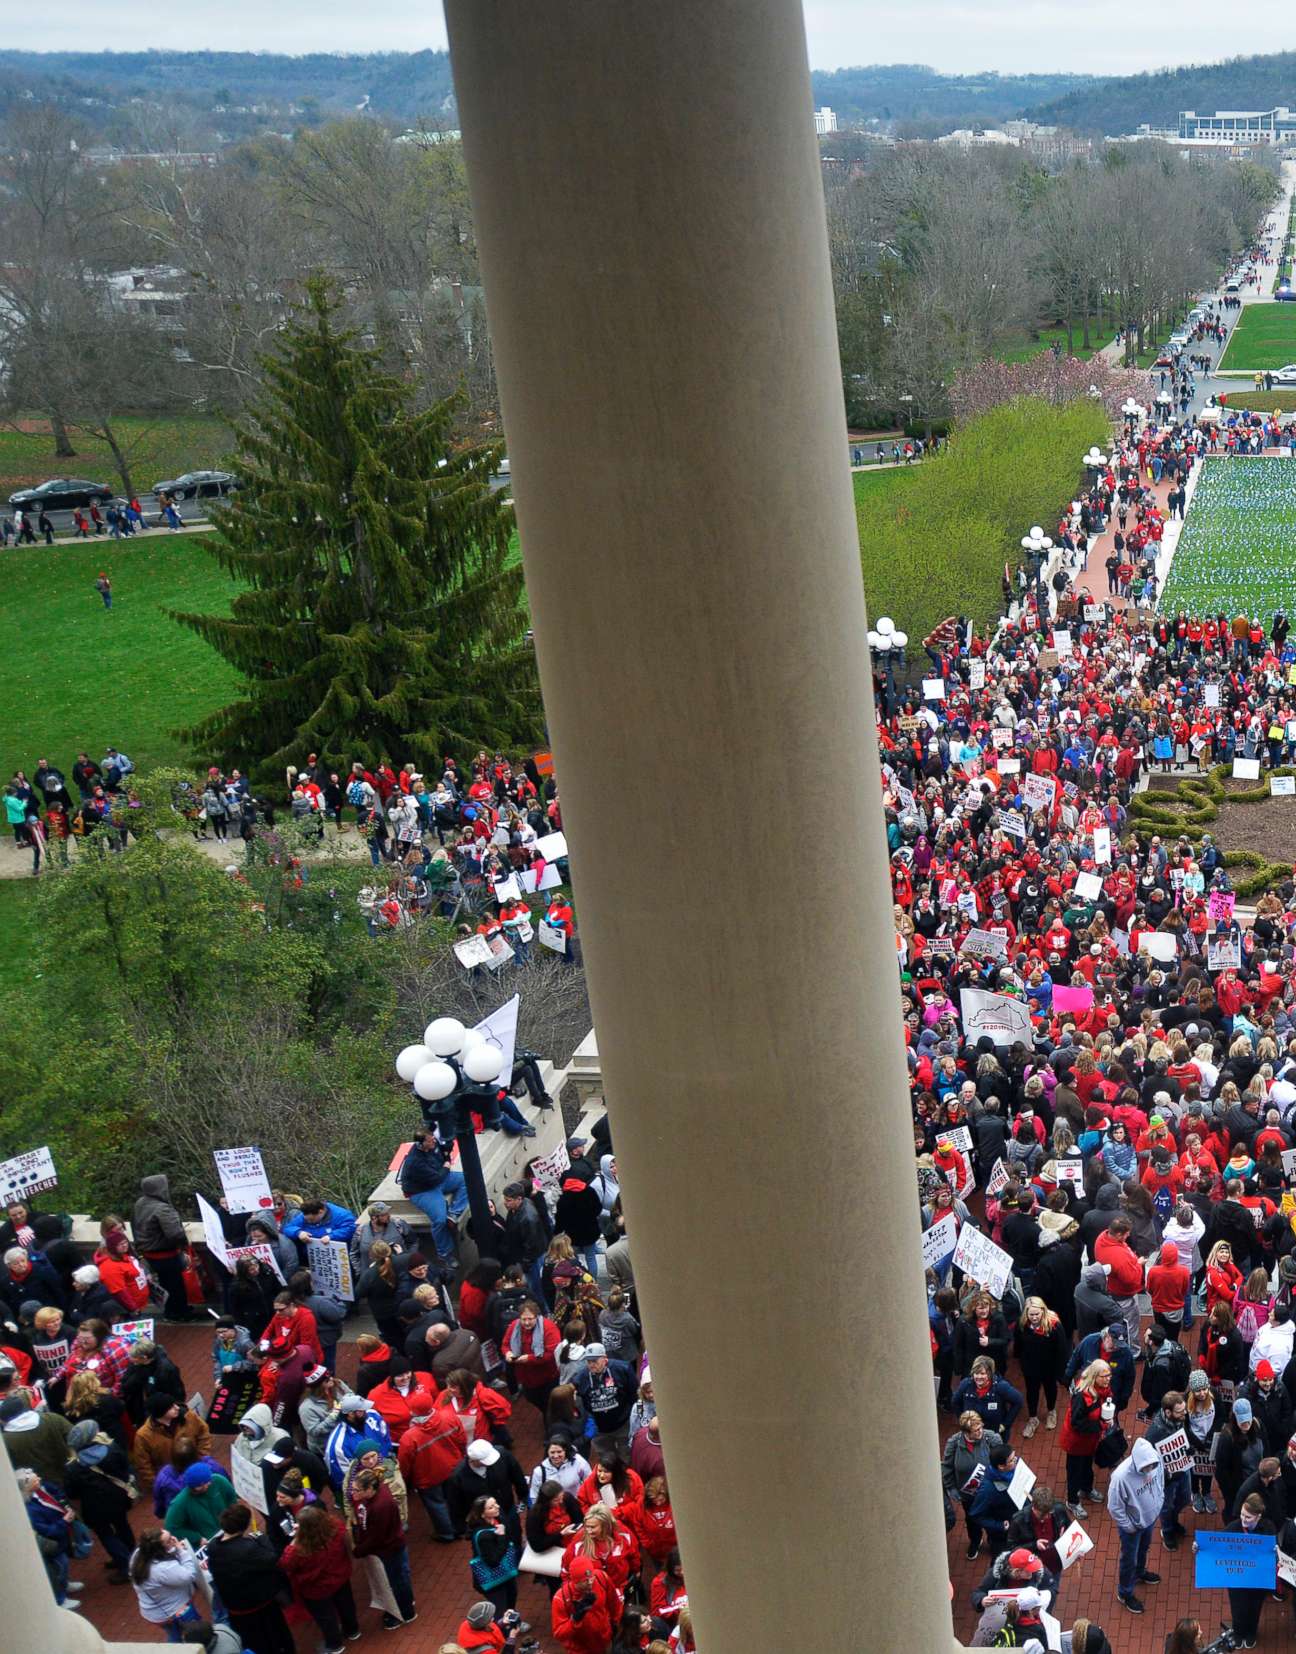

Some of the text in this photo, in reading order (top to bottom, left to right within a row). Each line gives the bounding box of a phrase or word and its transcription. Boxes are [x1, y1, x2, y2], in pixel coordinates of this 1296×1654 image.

[15, 1151, 41, 1163] SMART
[20, 1157, 38, 1166] KIND
[8, 1158, 51, 1178] IMPORTANT
[228, 1166, 248, 1174] WON'T
[233, 1170, 263, 1179] FLUSHED
[24, 1176, 58, 1197] TEACHER
[225, 1249, 243, 1260] THIS
[263, 1245, 270, 1253] A
[36, 1345, 65, 1360] FUND
[210, 1388, 229, 1419] FUND
[232, 1386, 254, 1425] PUBLIC
[1159, 1434, 1186, 1455] FUND
[1163, 1445, 1187, 1464] OUR
[1165, 1455, 1192, 1474] FUTURE
